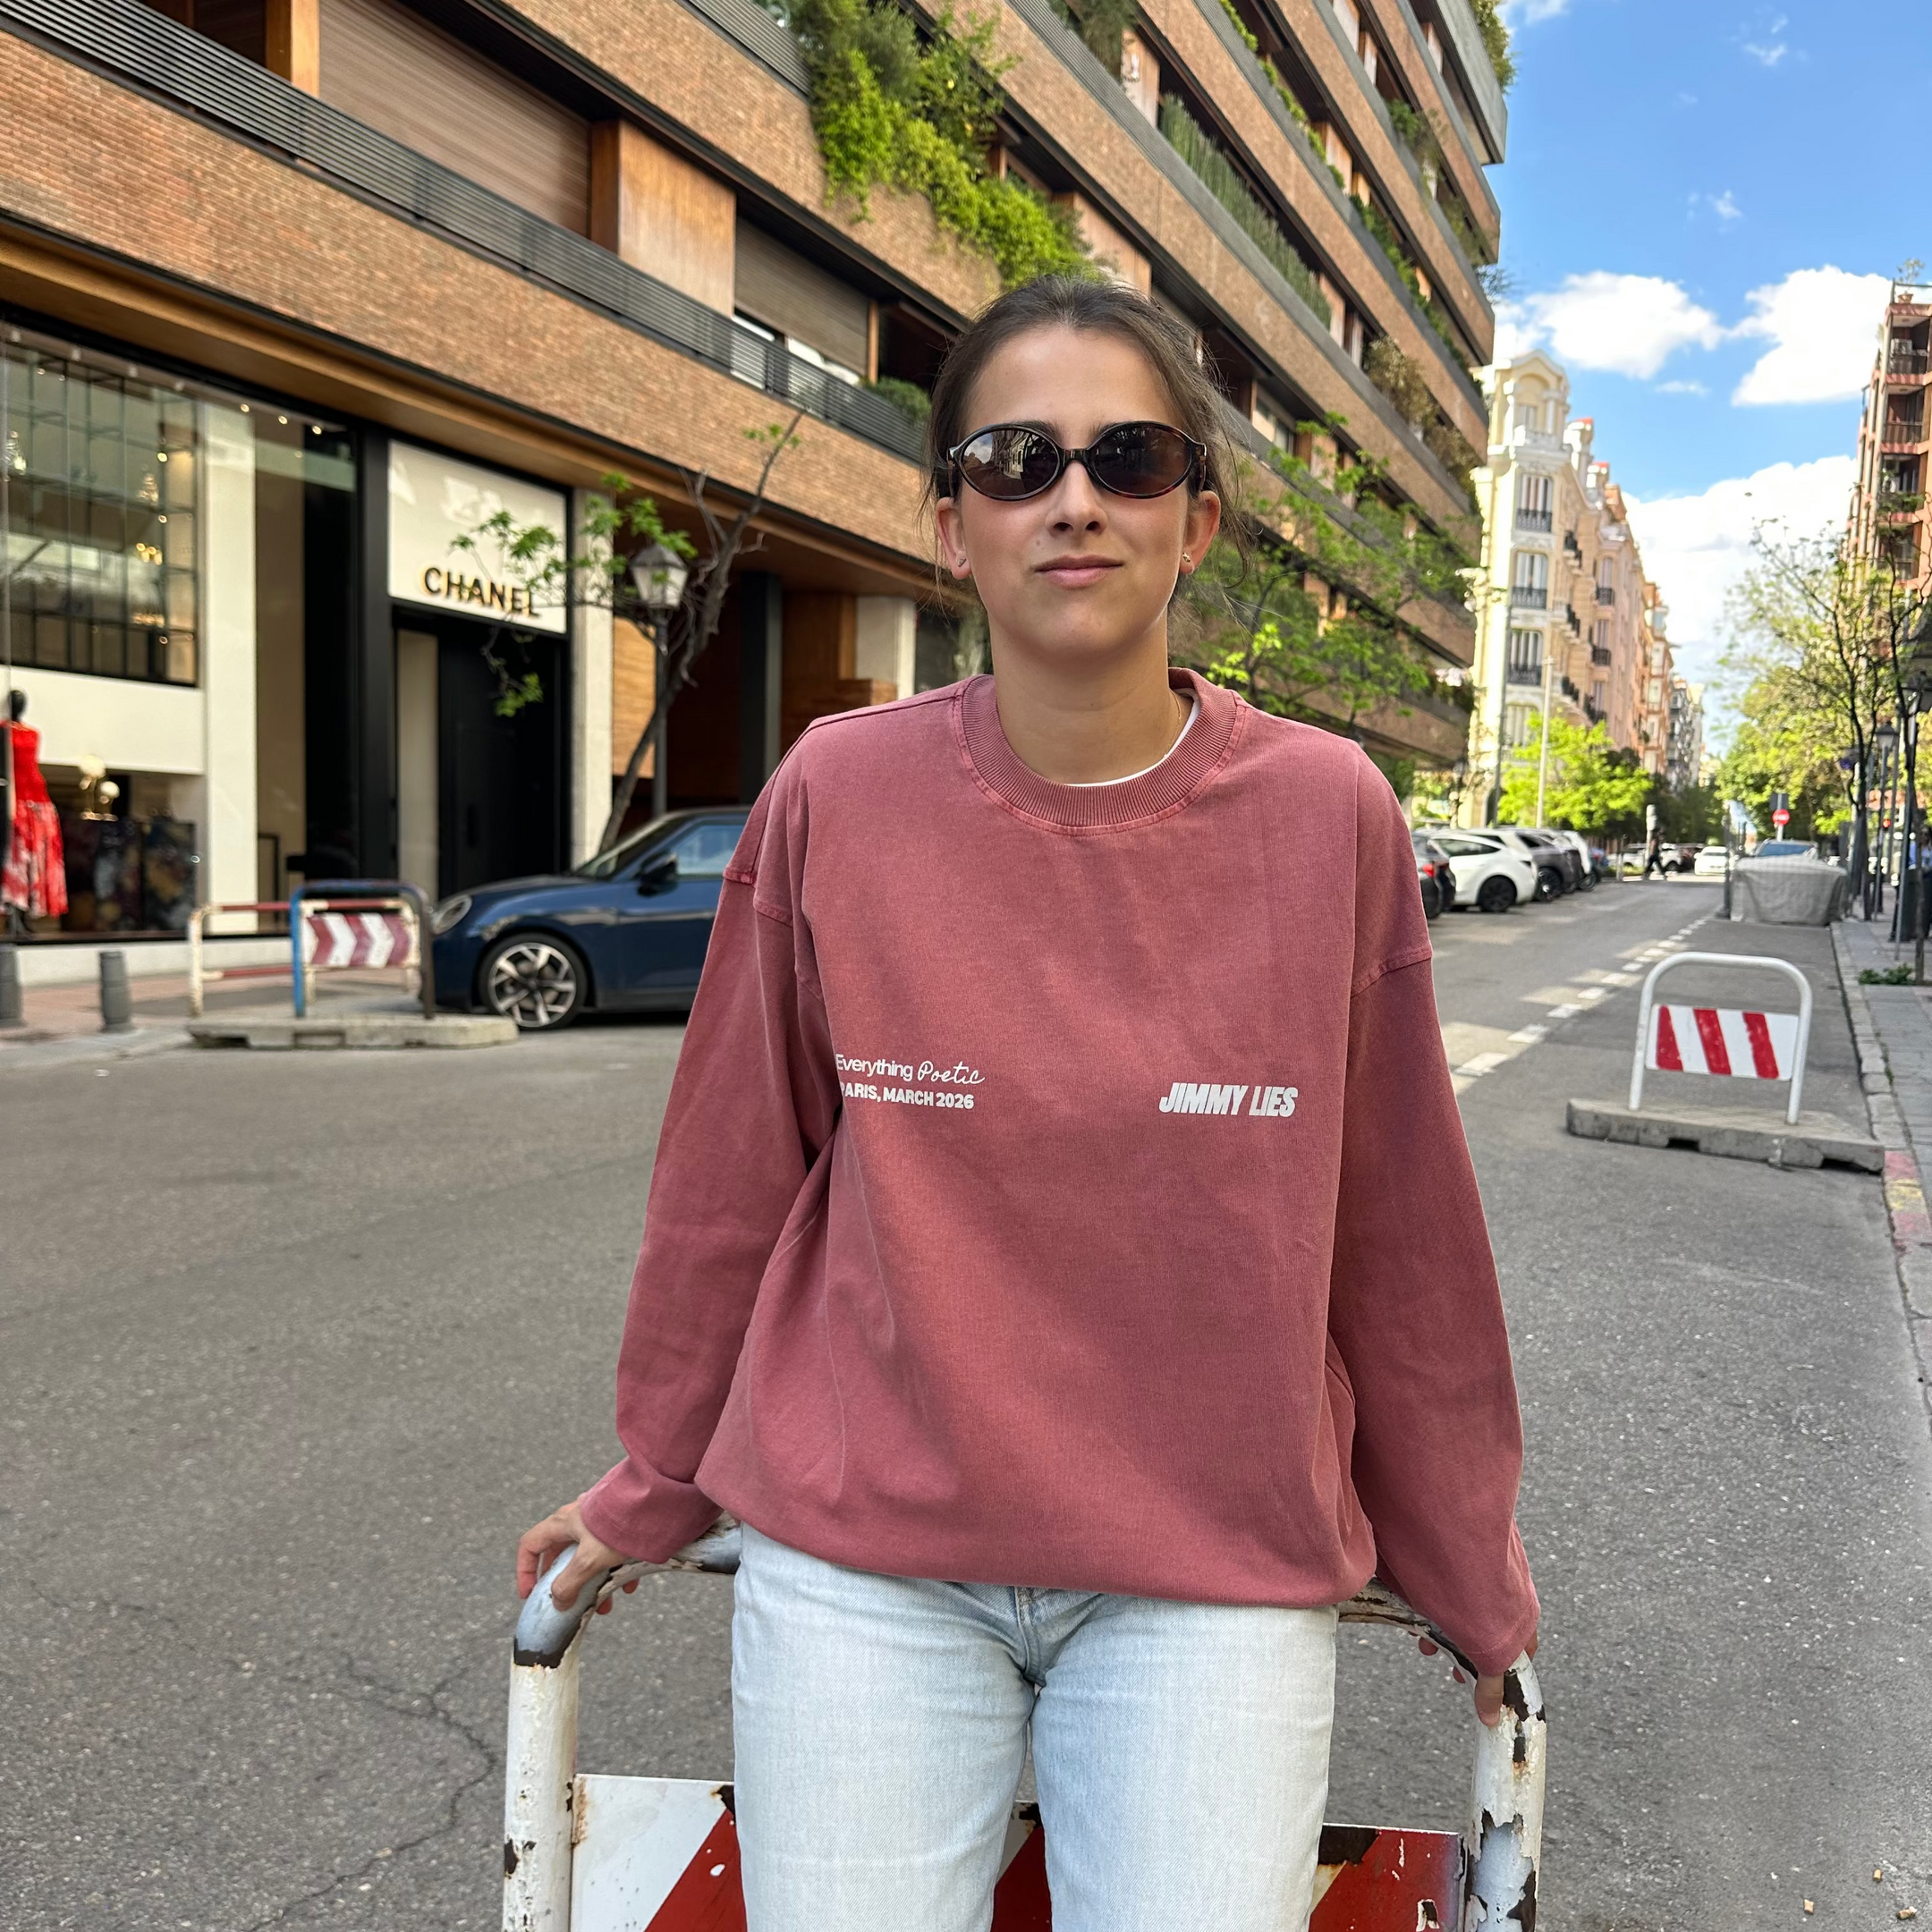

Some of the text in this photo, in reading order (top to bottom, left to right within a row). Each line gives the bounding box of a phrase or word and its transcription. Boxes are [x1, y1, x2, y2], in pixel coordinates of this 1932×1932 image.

[424, 567, 540, 617] CHANEL
[835, 1054, 986, 1084] Everything Poetic
[883, 1087, 934, 1106] MARCH
[936, 1091, 974, 1109] 2026
[1158, 1082, 1299, 1118] JIMMY LIES
